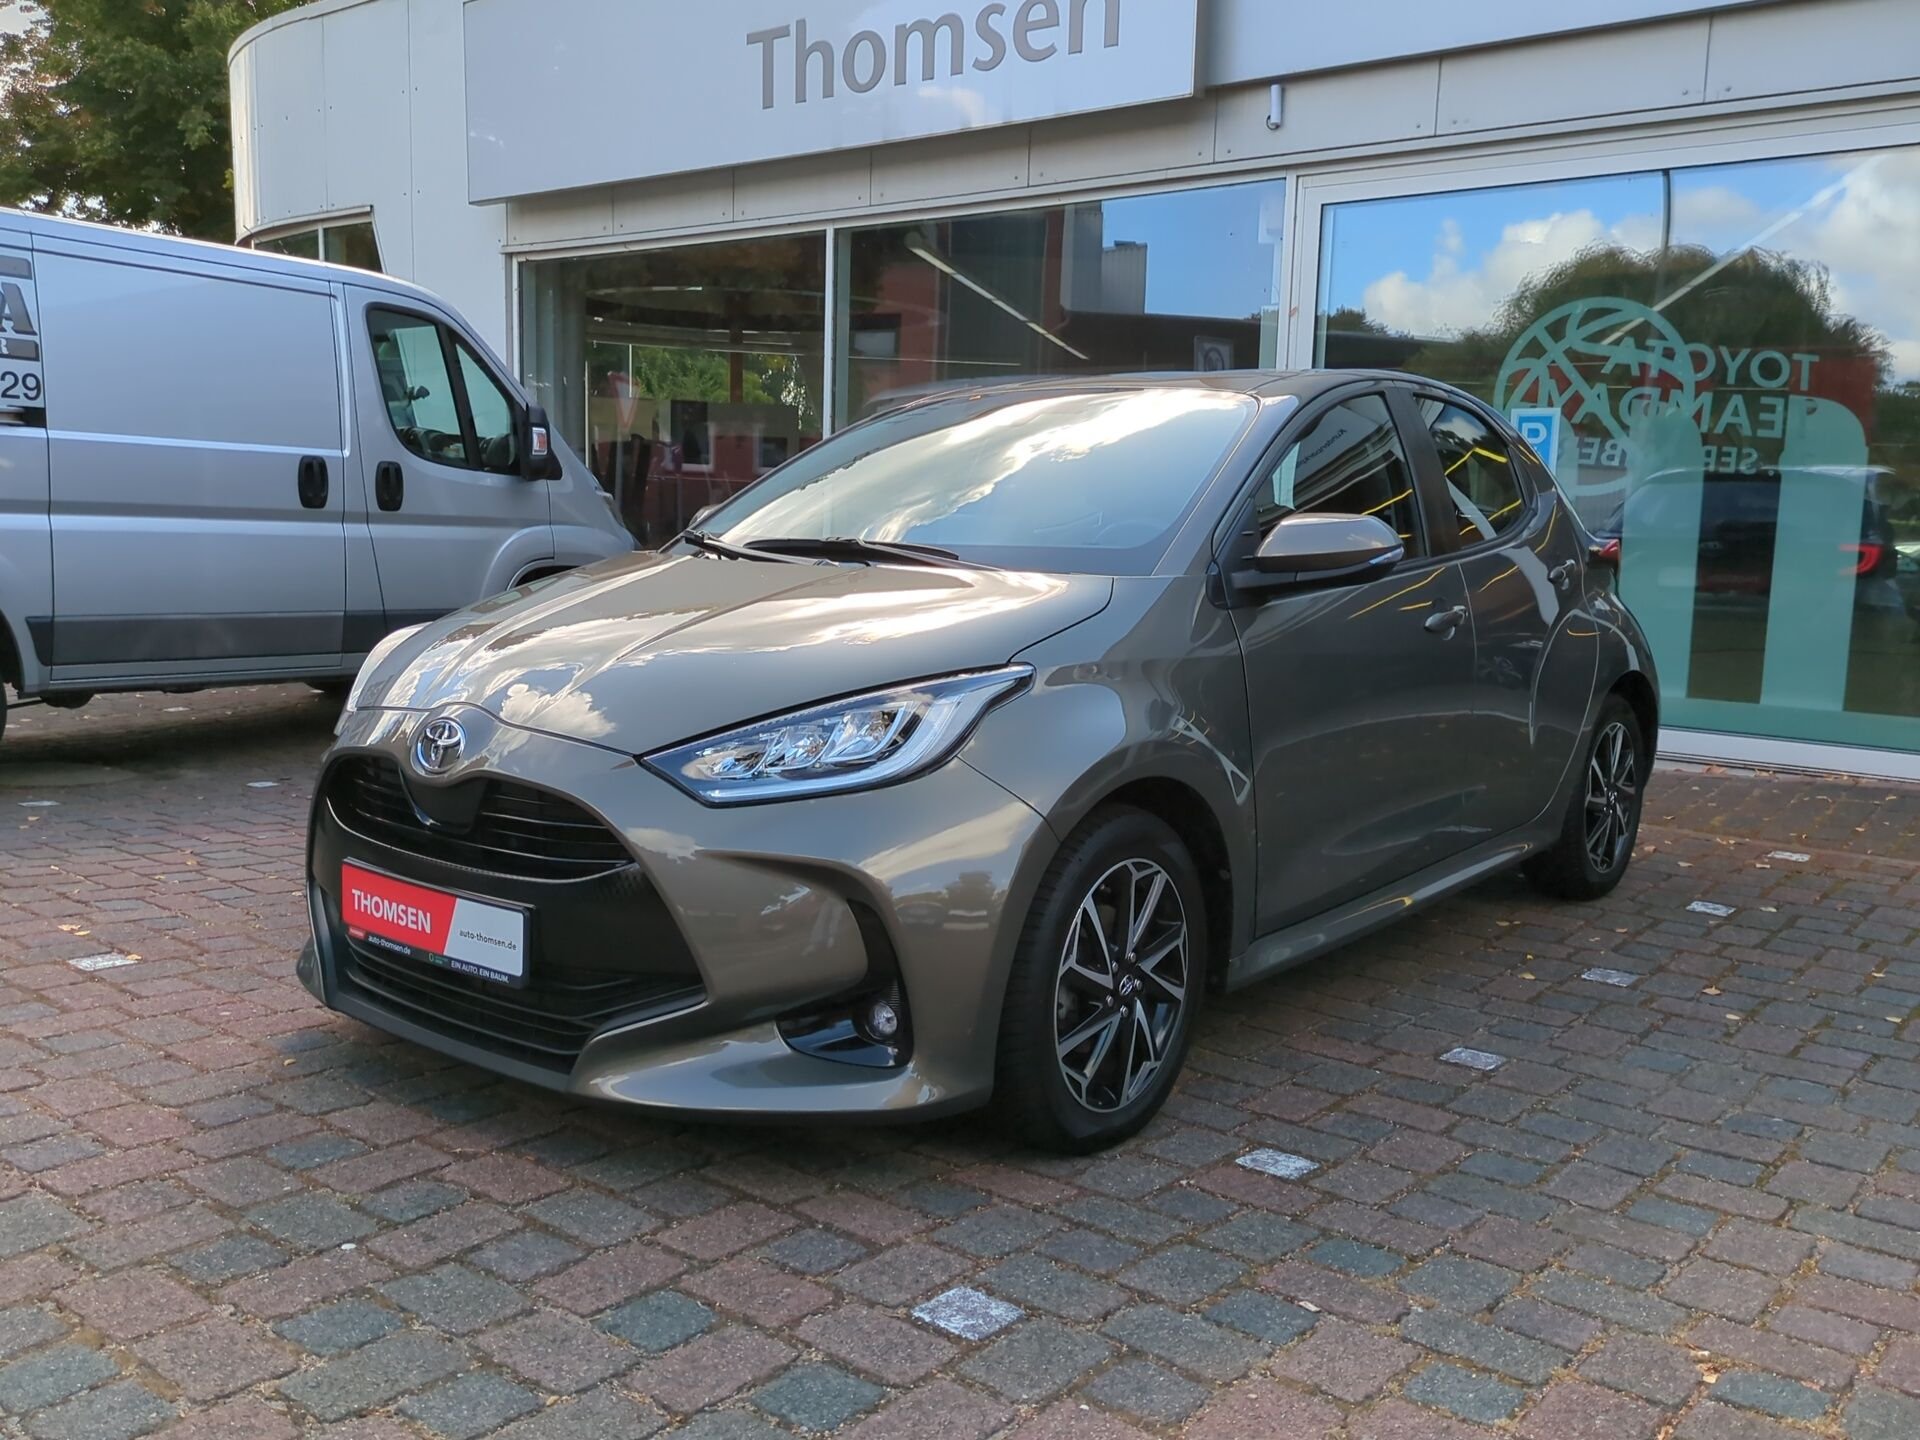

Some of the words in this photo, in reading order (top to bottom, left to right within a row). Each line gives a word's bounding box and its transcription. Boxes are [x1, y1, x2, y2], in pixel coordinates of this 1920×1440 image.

[746, 0, 1120, 109] Thomsen
[0, 371, 42, 401] 29
[351, 888, 431, 934] THOMSEN
[367, 935, 411, 956] auto-thomsen.de
[459, 928, 517, 951] auto-thomsen.de
[451, 960, 462, 969] EIN
[479, 968, 490, 978] EIN
